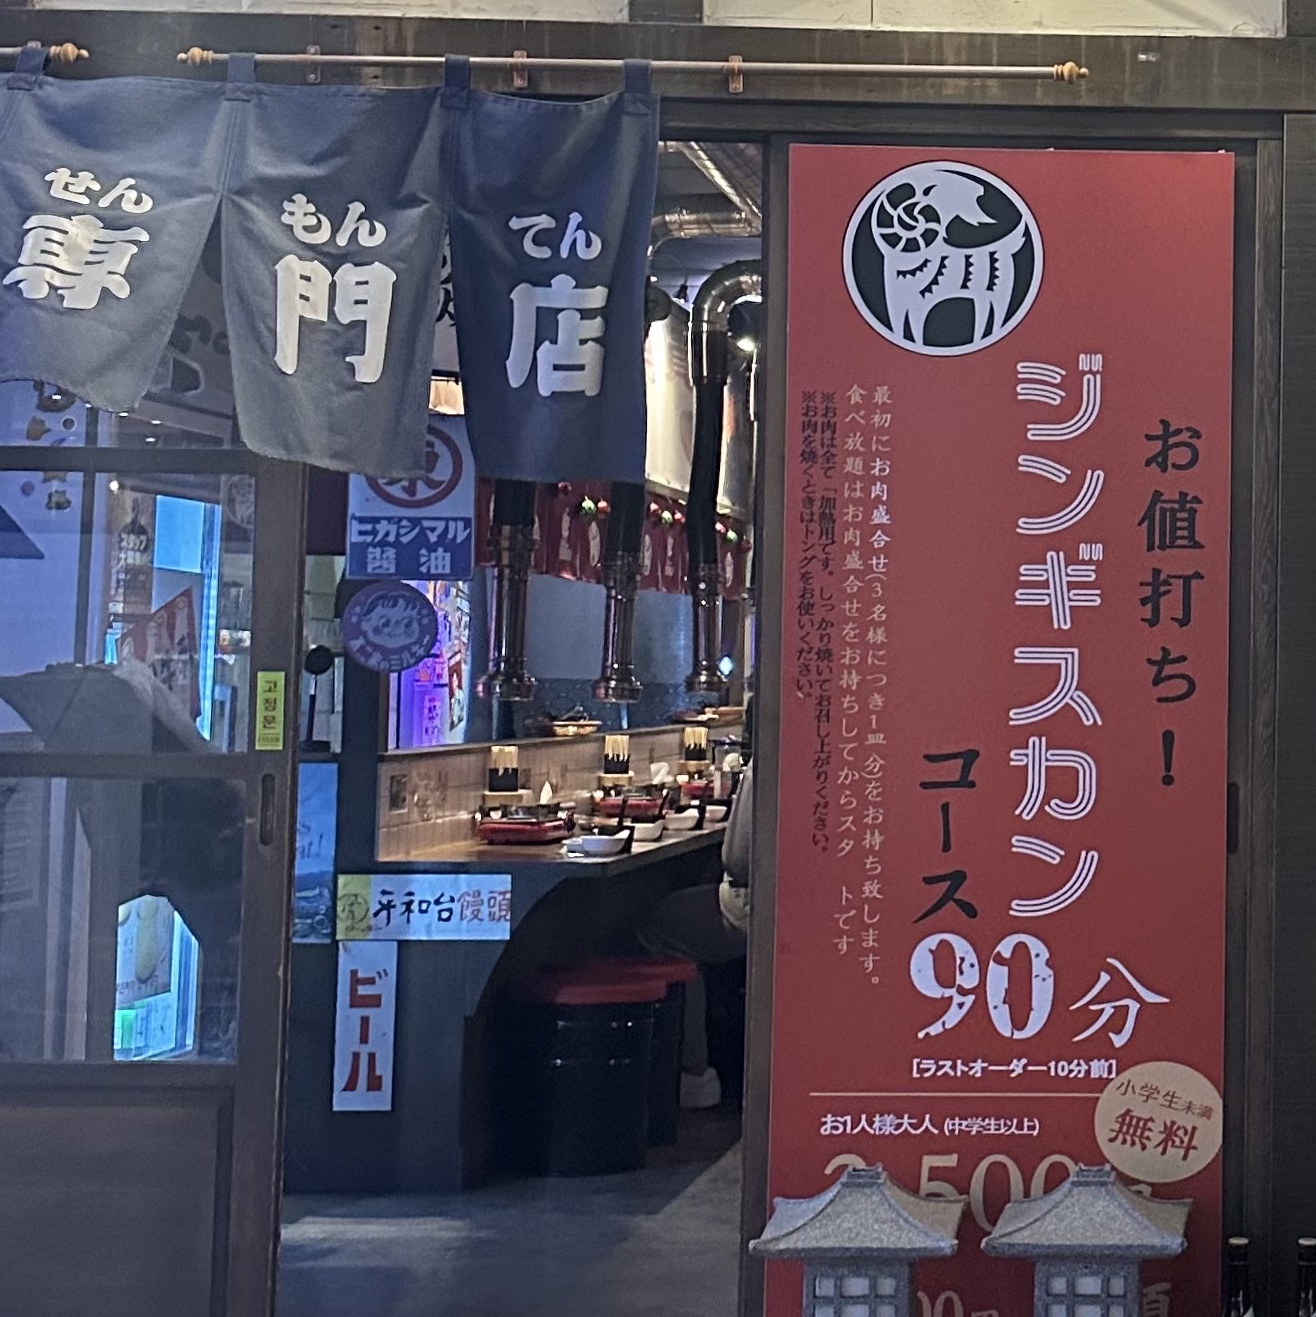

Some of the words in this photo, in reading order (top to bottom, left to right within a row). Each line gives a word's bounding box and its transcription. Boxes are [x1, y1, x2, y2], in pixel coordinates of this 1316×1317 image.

[44, 167, 154, 213] せん
[281, 194, 387, 247] もん
[508, 212, 602, 260] てん
[273, 255, 397, 383] 門
[505, 274, 608, 397] 店
[350, 519, 471, 544] ヒガシマル
[1009, 353, 1104, 917] ジンギスカン
[262, 679, 279, 731] 고정문
[912, 748, 981, 924] コース
[340, 967, 390, 1093] ビール
[909, 932, 1171, 1048] 90分
[820, 1113, 939, 1136] お1人様大人
[1107, 1108, 1200, 1162] 無料
[1114, 1078, 1215, 1121] 小学生未満
